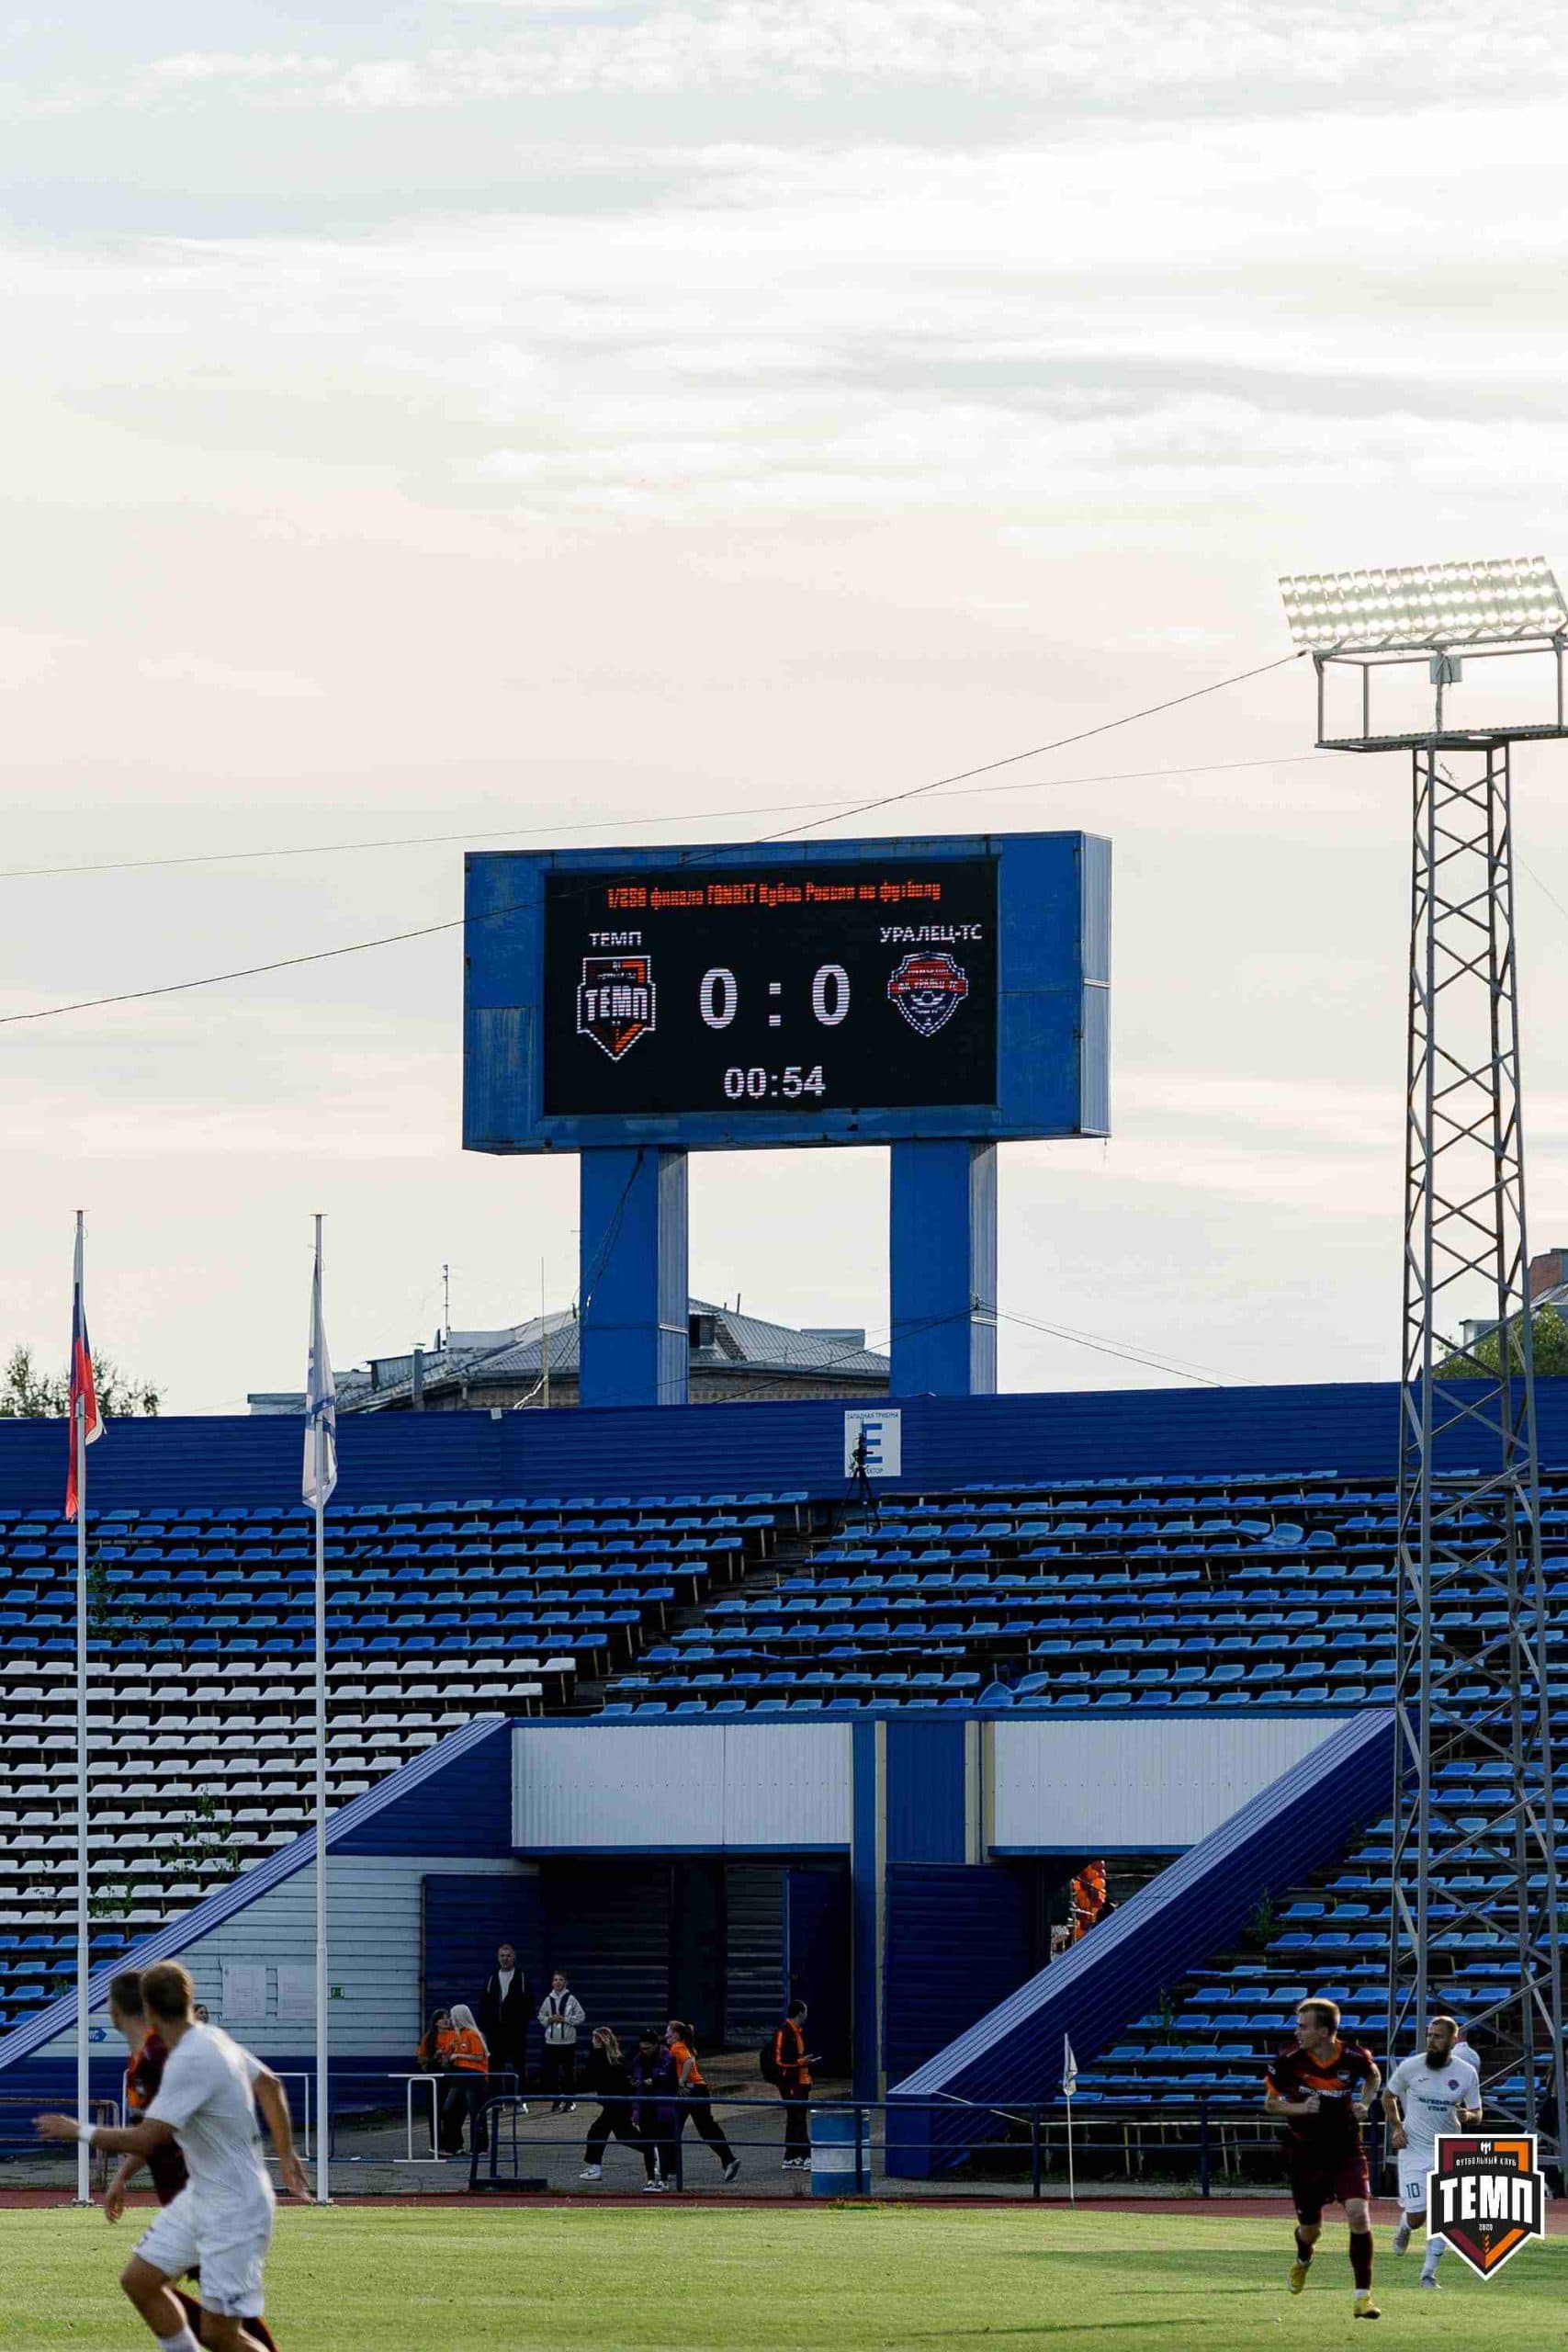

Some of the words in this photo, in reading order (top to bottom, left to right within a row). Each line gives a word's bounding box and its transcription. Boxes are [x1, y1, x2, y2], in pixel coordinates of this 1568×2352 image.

[650, 886, 704, 910] финала
[759, 882, 802, 908] Кубка
[805, 882, 855, 902] России
[859, 885, 875, 899] по
[879, 880, 942, 902] футболу
[589, 930, 642, 947] ТЕМП
[879, 923, 983, 944] УРАЛЕЦ-ТС
[584, 984, 648, 1022] ТЕМП
[699, 967, 739, 1030] 0
[811, 964, 851, 1026] 0
[723, 1065, 827, 1101] 00:54
[1405, 2182, 1421, 2199] 10
